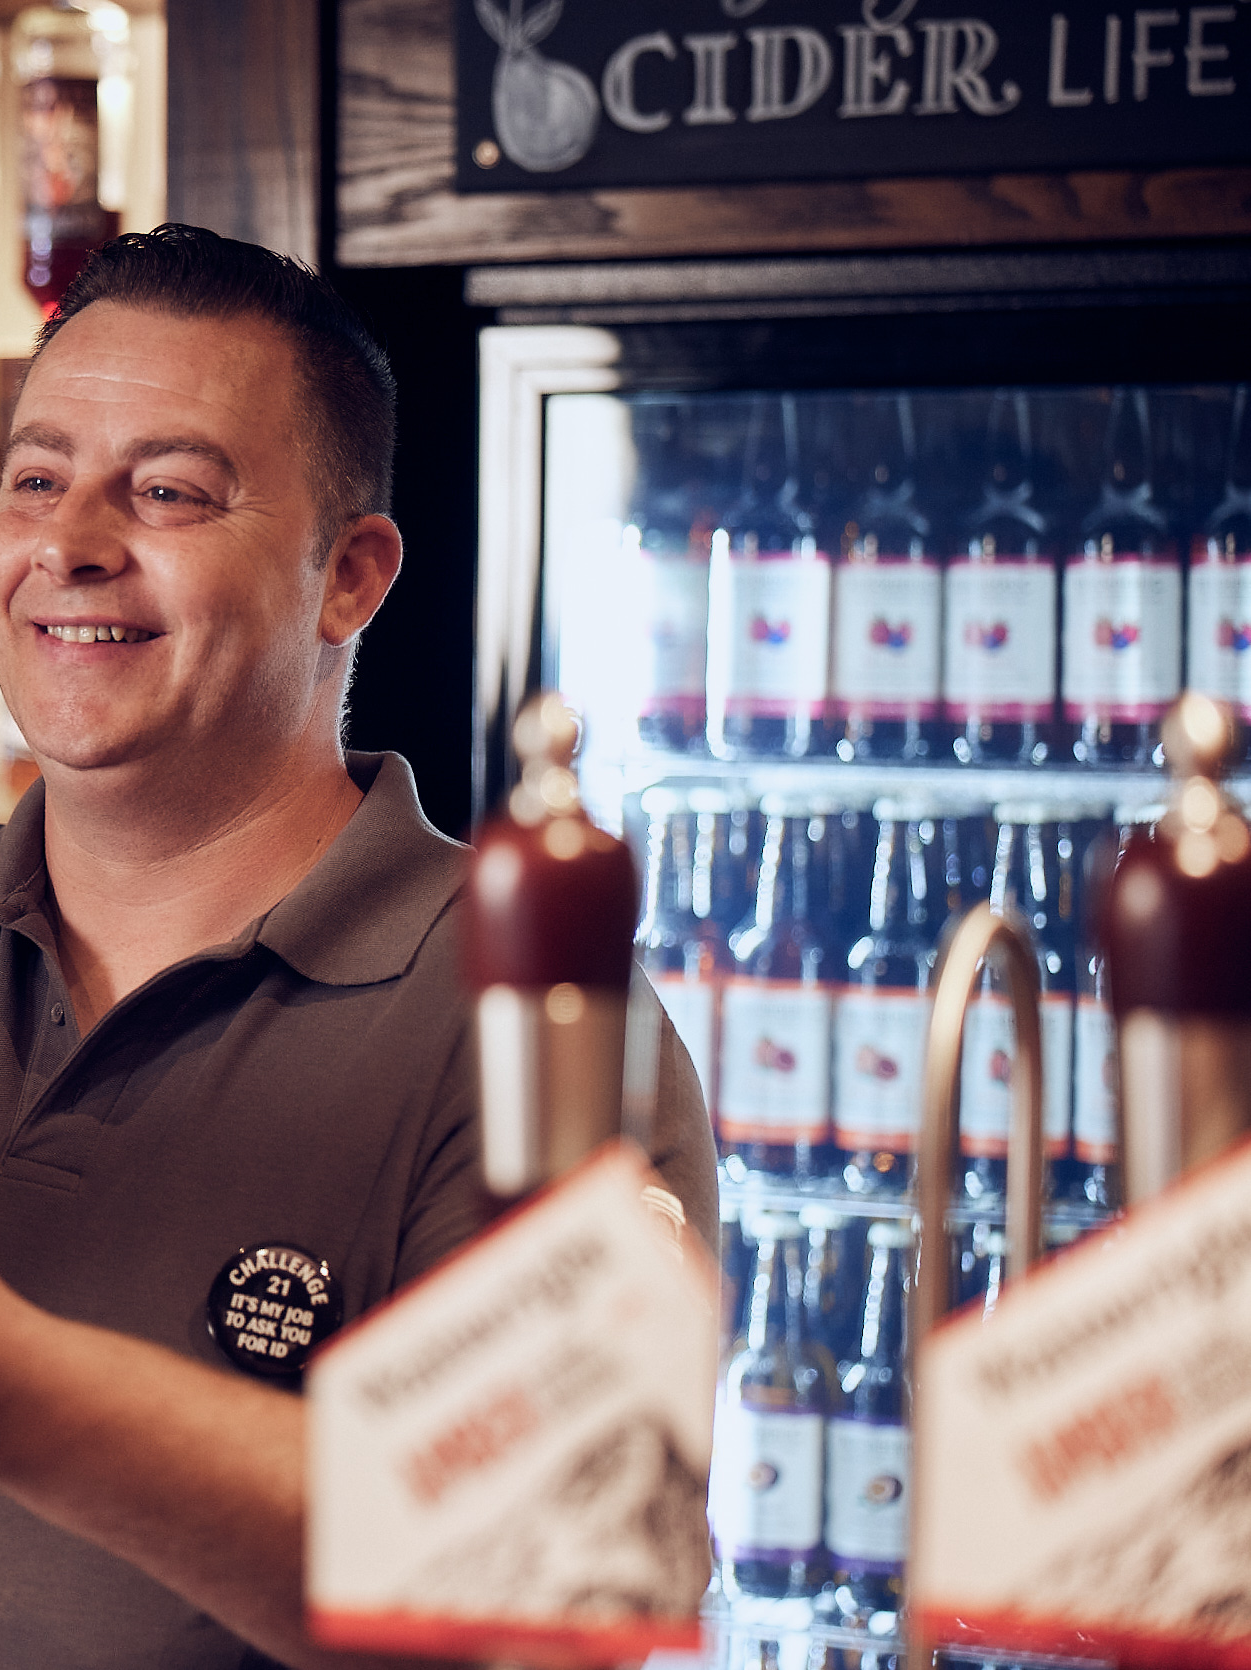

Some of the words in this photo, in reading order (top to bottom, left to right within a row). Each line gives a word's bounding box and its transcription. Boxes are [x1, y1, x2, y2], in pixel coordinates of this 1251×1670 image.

[601, 18, 1021, 134] CIDER
[1046, 5, 1237, 108] LIFE
[229, 1249, 329, 1306] CHALLENGE
[266, 1275, 291, 1297] 21
[230, 1292, 259, 1313] IT'S
[259, 1300, 285, 1319] MY
[283, 1306, 314, 1327] JOB
[225, 1310, 247, 1328] TO
[245, 1317, 278, 1338] ASK
[280, 1324, 312, 1345] YOU
[236, 1332, 268, 1354] FOR
[268, 1341, 289, 1358] ID
